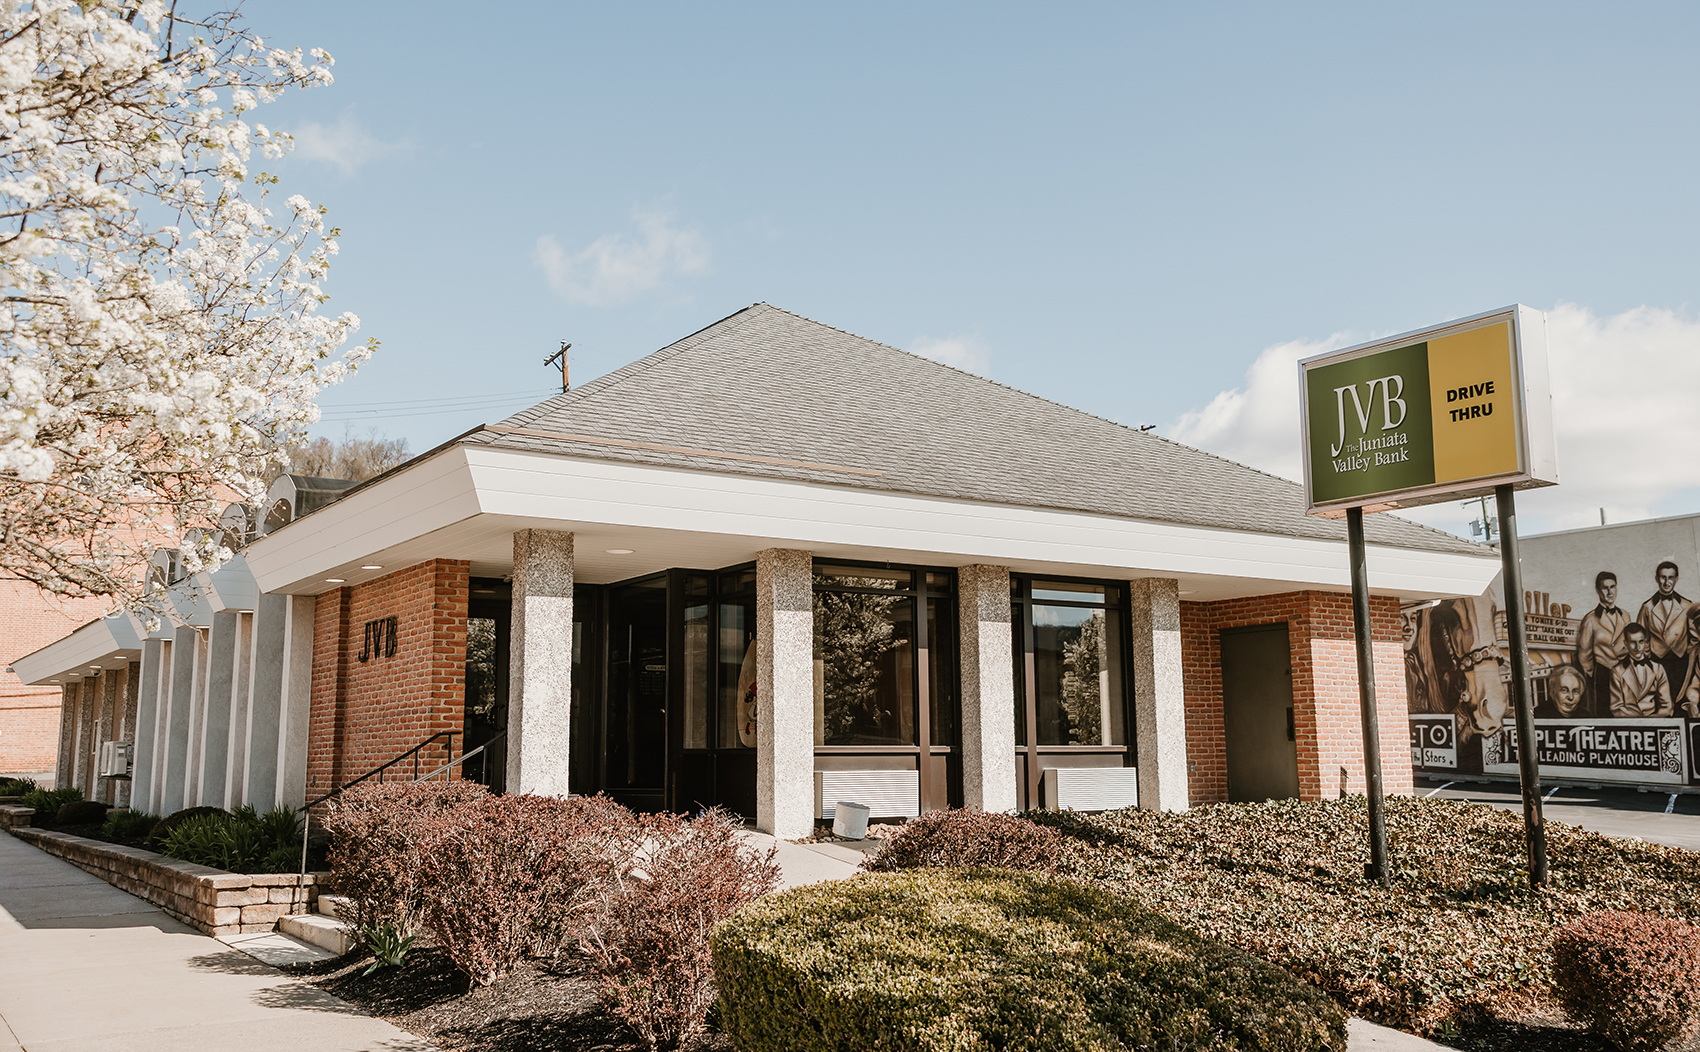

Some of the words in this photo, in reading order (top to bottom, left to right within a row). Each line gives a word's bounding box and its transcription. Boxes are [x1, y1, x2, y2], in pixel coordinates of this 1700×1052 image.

[1446, 381, 1495, 403] DRIVE
[1331, 374, 1407, 457] JVB
[1449, 402, 1493, 422] THRU
[1346, 444, 1359, 453] The
[1357, 432, 1408, 458] Juniata
[1332, 455, 1371, 473] Valley
[1374, 447, 1410, 466] Bank
[1525, 591, 1572, 619] iller
[358, 617, 397, 663] JVB
[1503, 725, 1567, 761] TEPLE
[1568, 726, 1656, 752] THEATRE
[1425, 750, 1446, 763] Stars
[1539, 751, 1585, 763] LEADING
[1589, 752, 1659, 766] PLAYHOUSE
